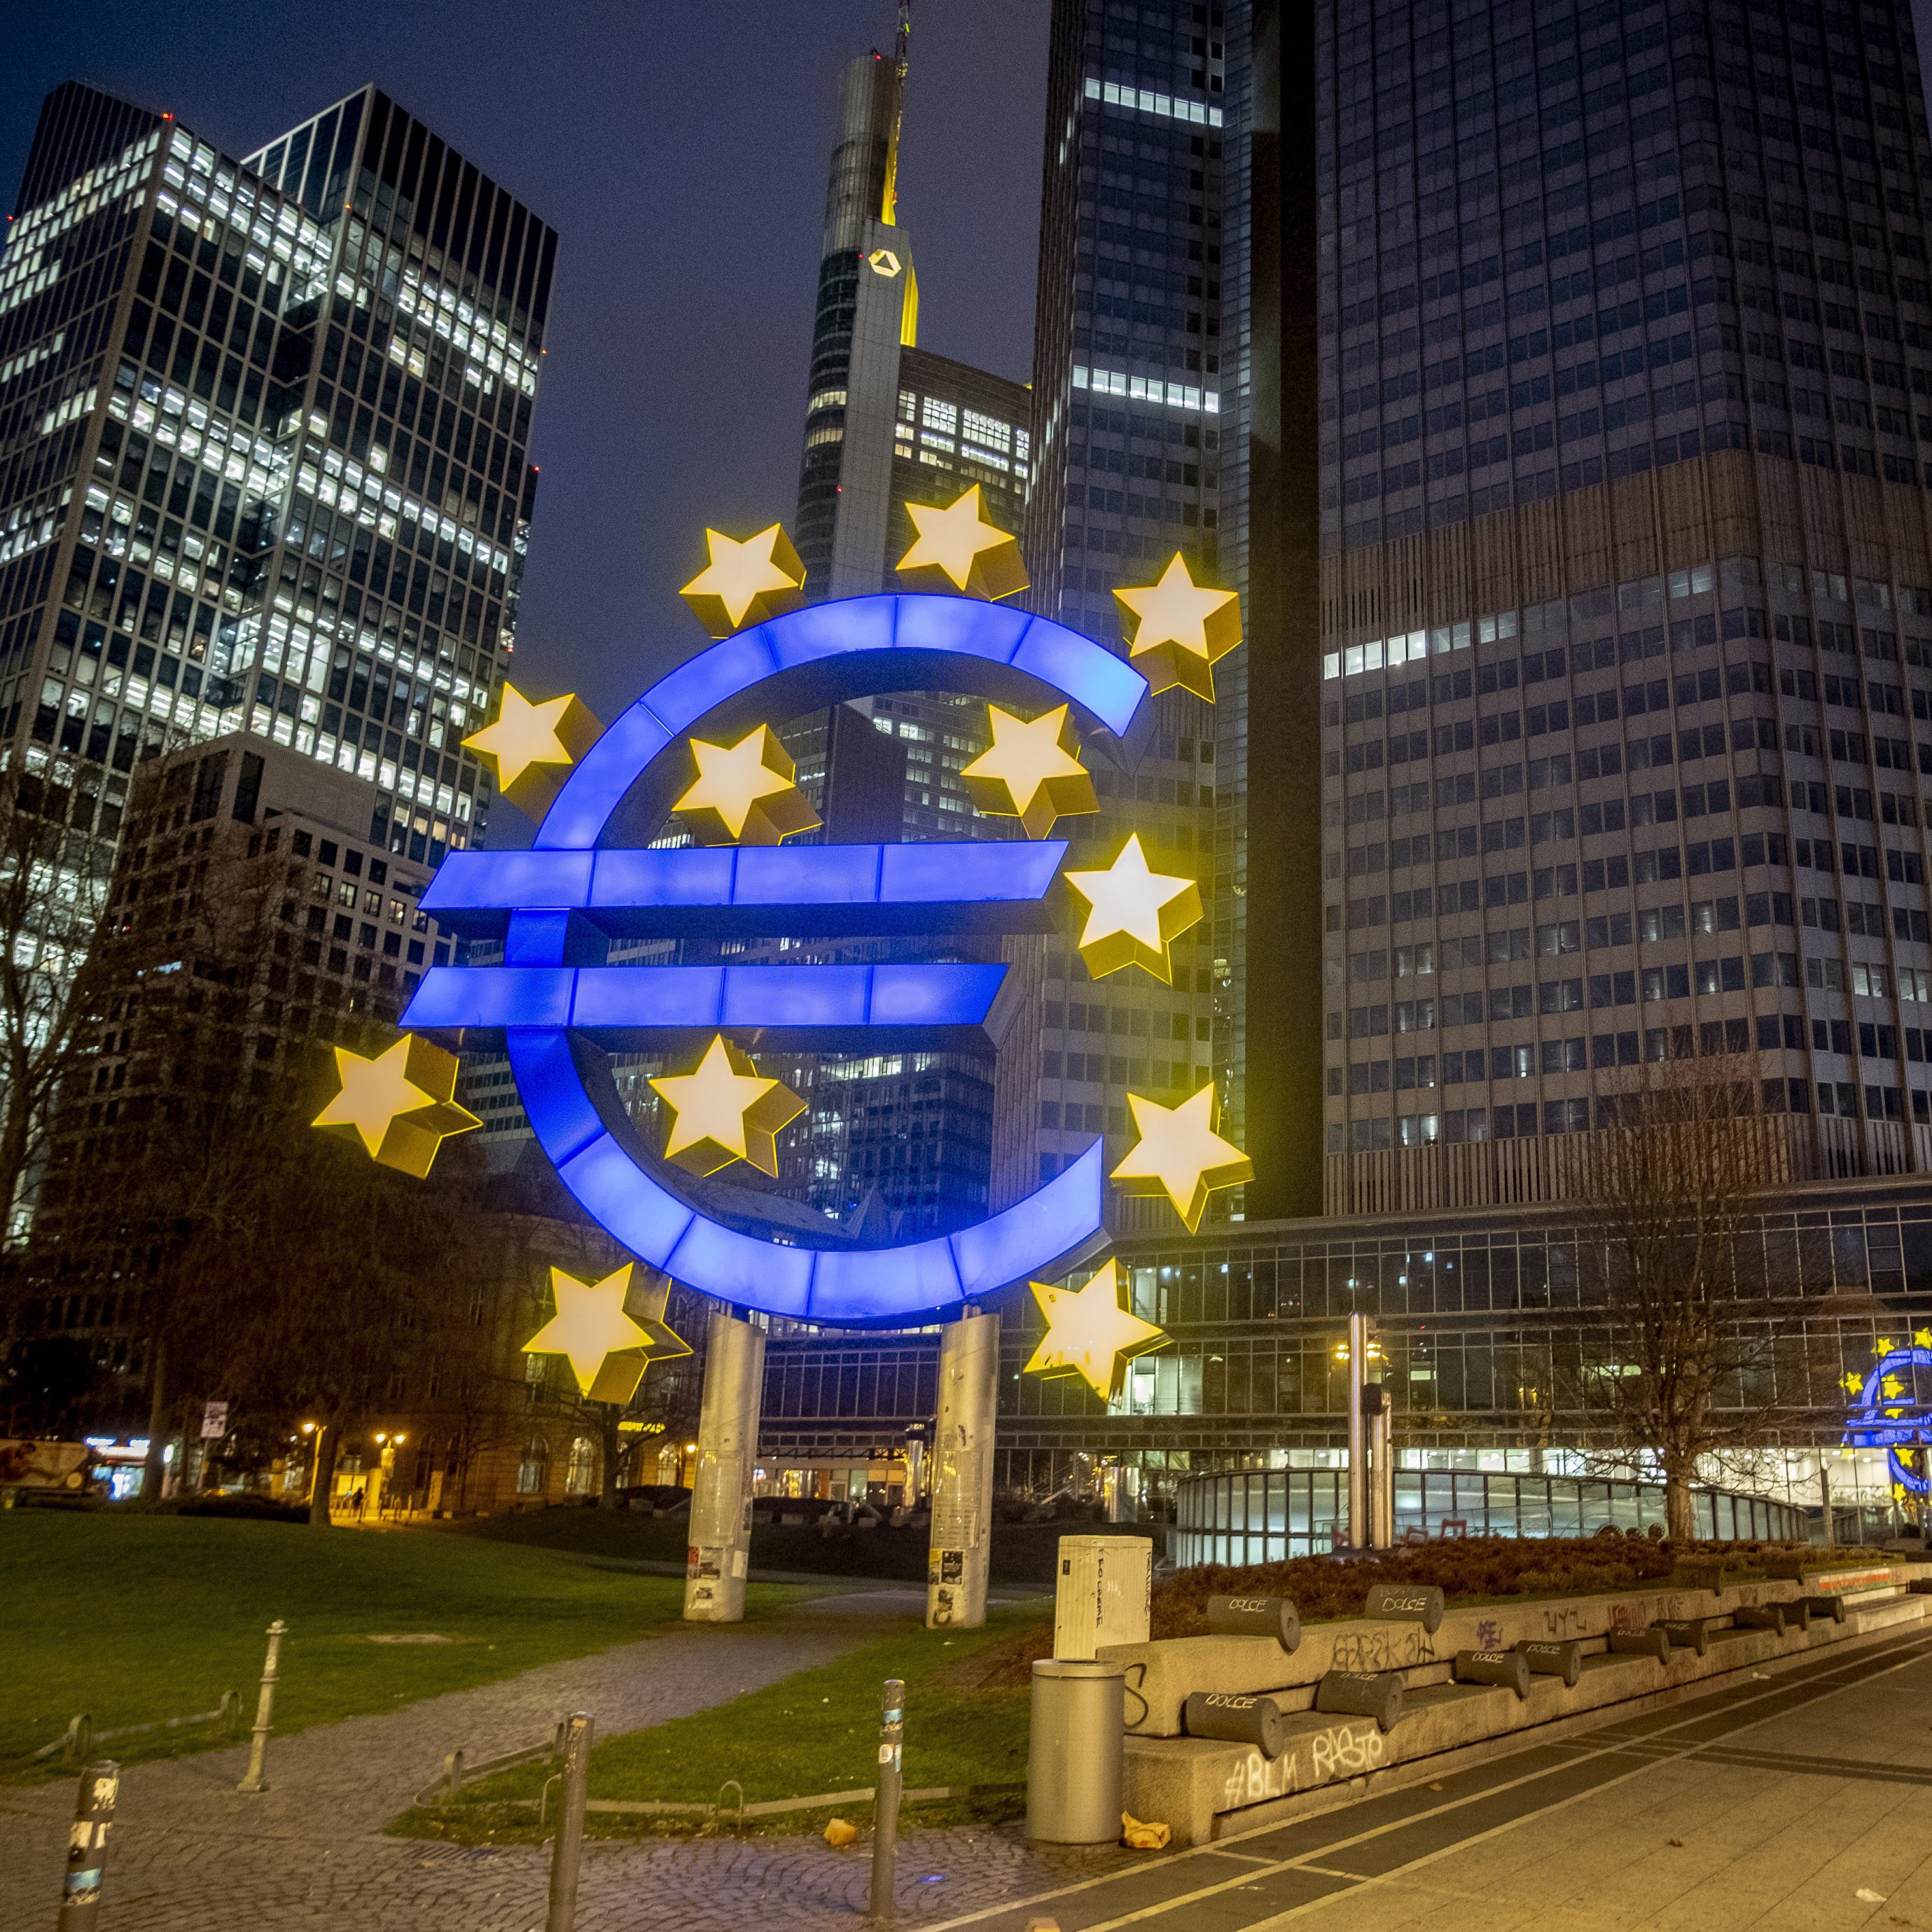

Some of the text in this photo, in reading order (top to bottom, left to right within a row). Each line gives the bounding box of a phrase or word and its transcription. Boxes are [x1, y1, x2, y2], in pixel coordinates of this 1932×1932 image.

[1228, 1598, 1267, 1613] DOLCE
[1382, 1597, 1427, 1611] DOLCE
[1527, 1643, 1561, 1655] DOLCE
[1472, 1652, 1505, 1664] DOLCE
[1204, 1693, 1258, 1709] DOLCE
